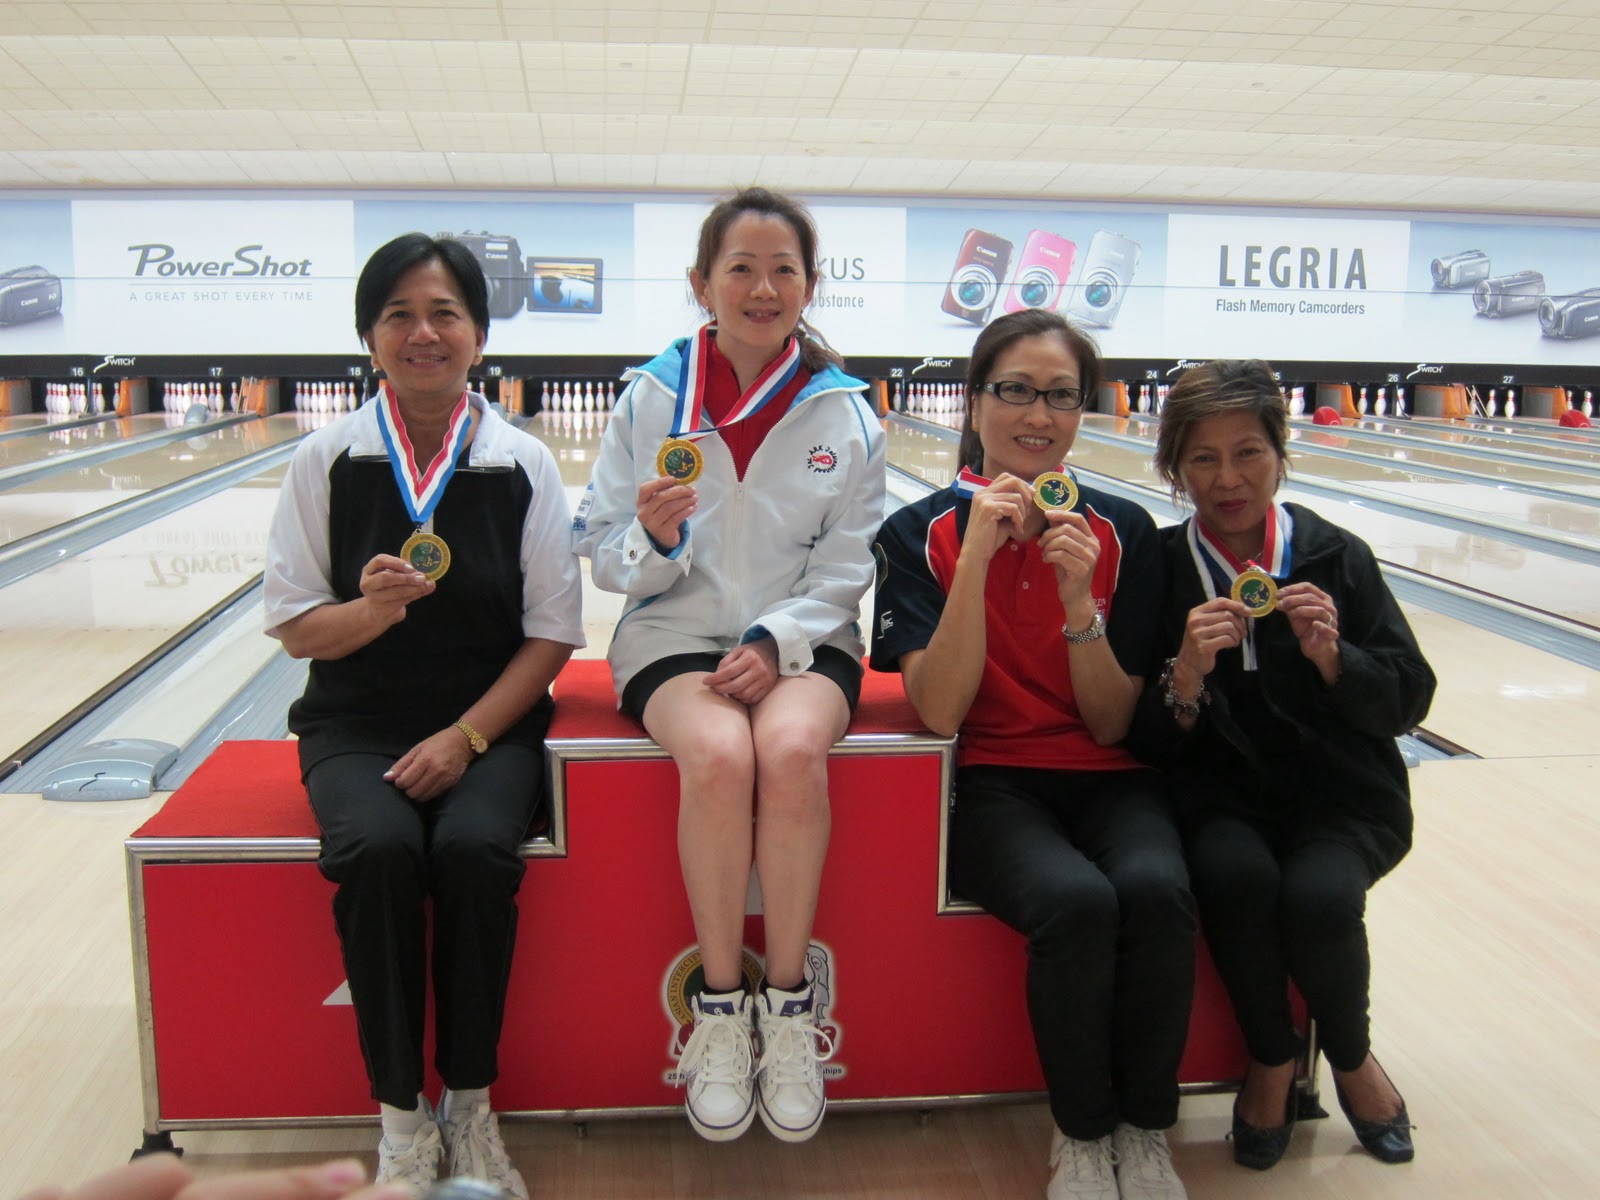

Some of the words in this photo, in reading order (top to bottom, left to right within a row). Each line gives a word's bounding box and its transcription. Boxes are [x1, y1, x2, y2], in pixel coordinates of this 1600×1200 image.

[127, 243, 312, 277] PowerShot
[1219, 244, 1367, 290] LEGRIA
[129, 291, 138, 301] A
[144, 291, 186, 301] GREAT
[193, 291, 229, 301] SHOT
[235, 291, 276, 301] EVERY
[282, 291, 313, 301] TIME
[1216, 298, 1246, 312] Flash
[1250, 299, 1296, 316] Memory
[1299, 300, 1366, 315] Camcorders
[72, 367, 84, 377] 16
[210, 367, 222, 377] 17
[350, 367, 361, 376] 18
[489, 367, 501, 376] 19
[891, 368, 903, 377] 22
[1147, 370, 1158, 380] 24
[1388, 374, 1399, 383] 26
[1502, 375, 1514, 384] 27
[670, 995, 688, 1020] ASIAN
